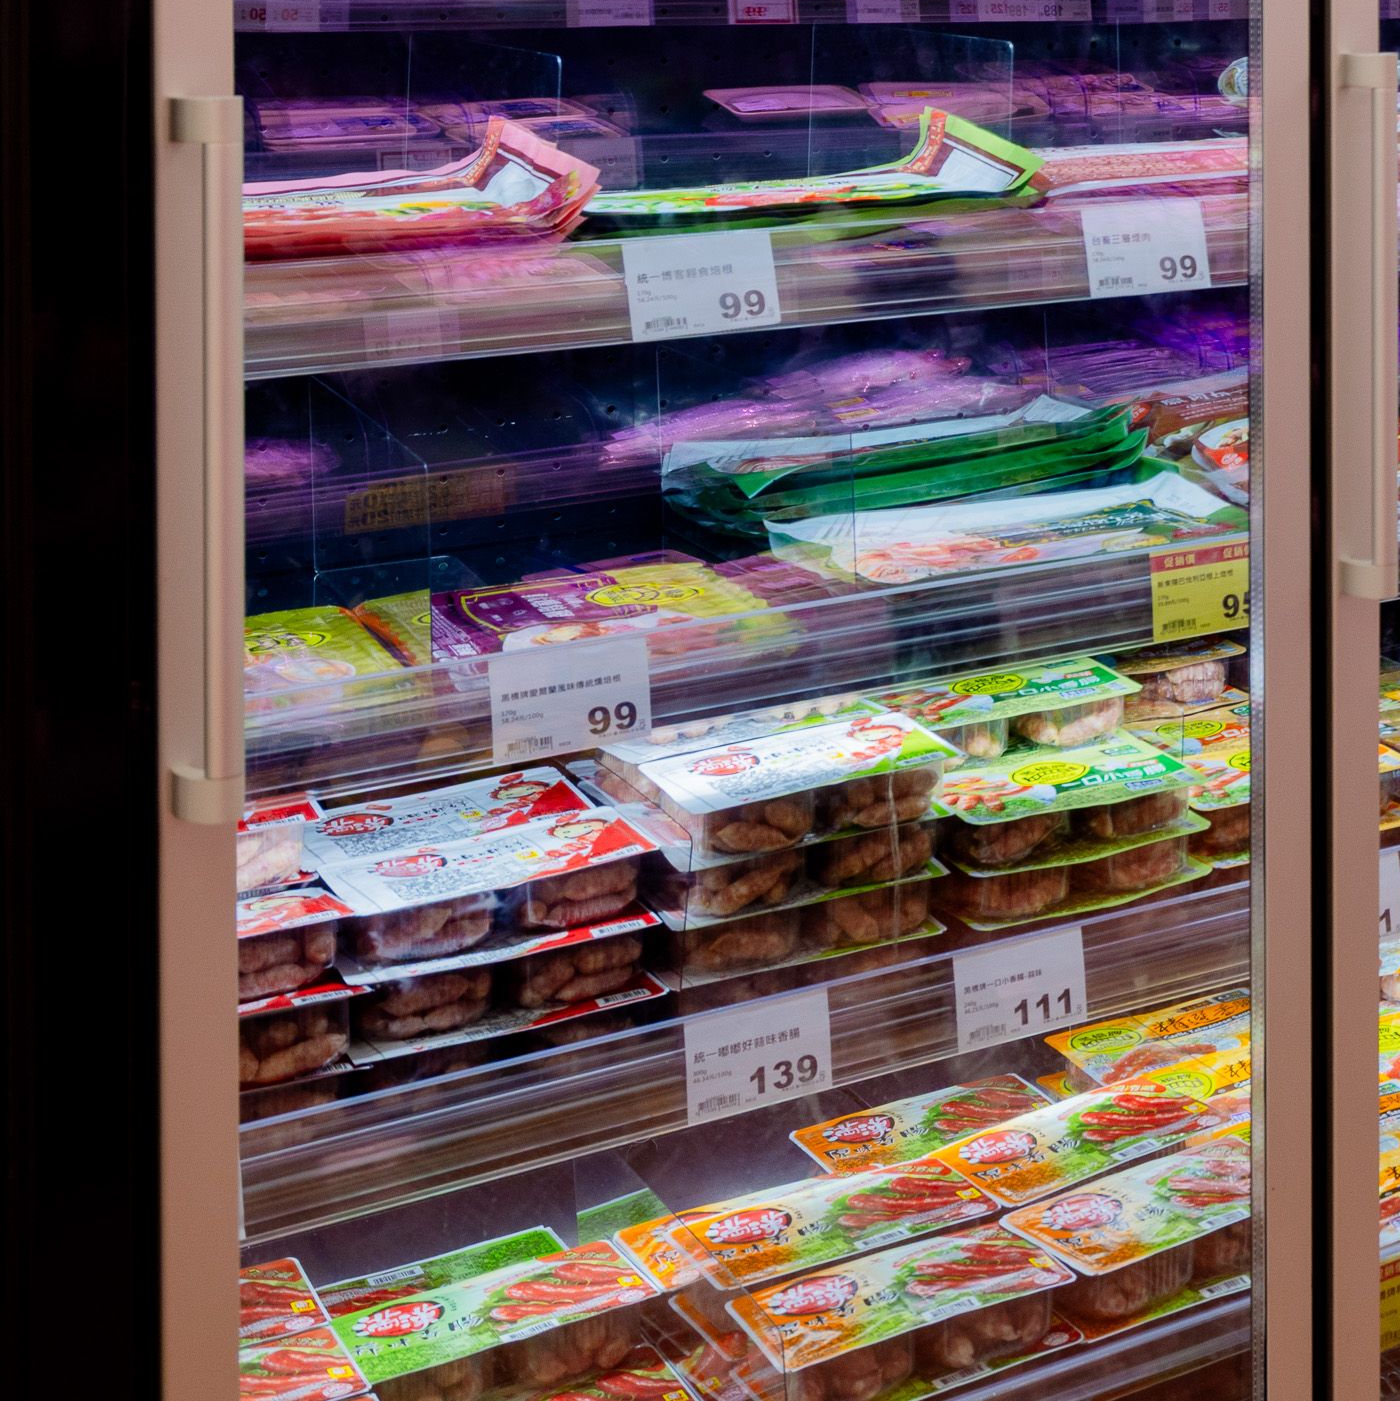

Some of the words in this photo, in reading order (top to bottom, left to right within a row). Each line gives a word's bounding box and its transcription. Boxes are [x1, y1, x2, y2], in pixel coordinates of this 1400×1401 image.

[1159, 255, 1197, 281] 99
[719, 290, 767, 320] 99
[588, 701, 638, 735] 99
[1013, 987, 1072, 1027] 111
[749, 1054, 819, 1096] 139
